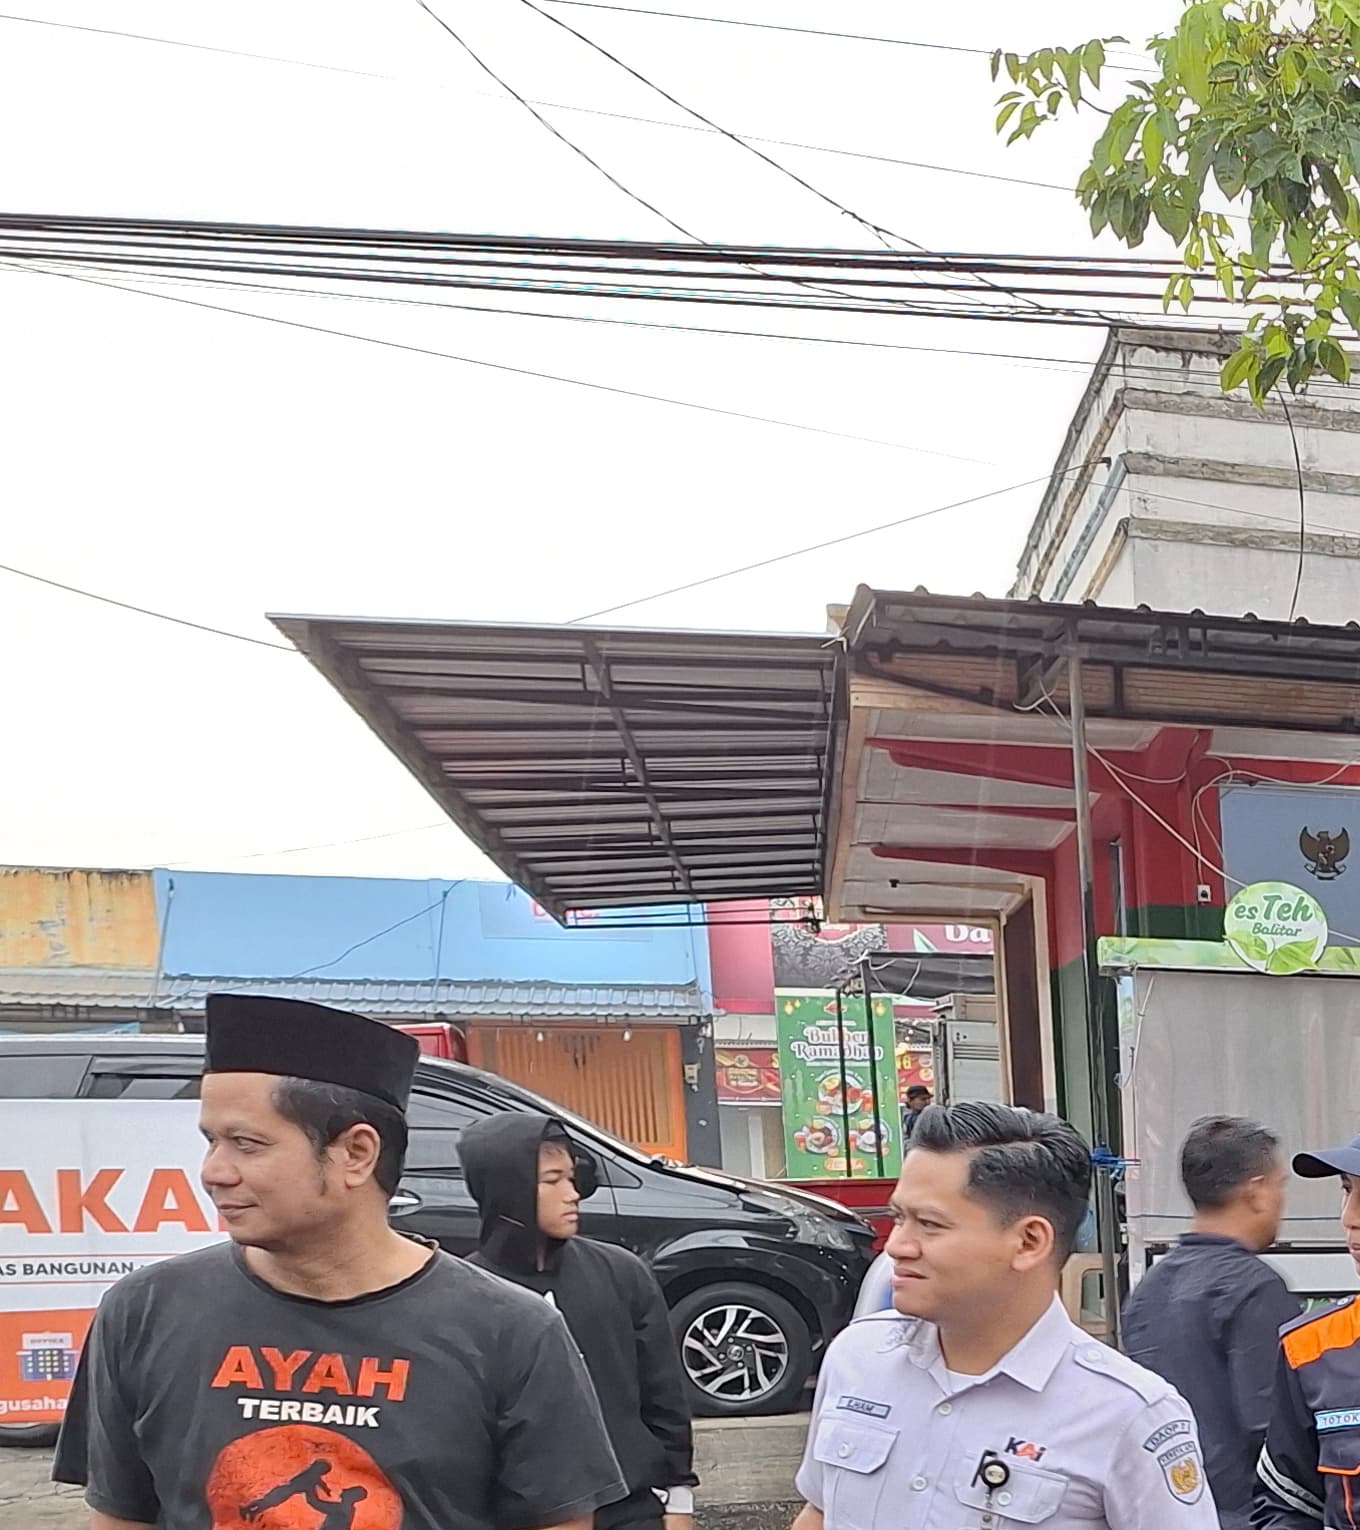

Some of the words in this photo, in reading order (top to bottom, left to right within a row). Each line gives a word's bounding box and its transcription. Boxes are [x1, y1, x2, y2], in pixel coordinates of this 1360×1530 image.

[1234, 904, 1259, 919] es
[1263, 894, 1314, 921] Teh
[0, 1168, 228, 1233] AKA
[22, 1261, 134, 1276] BANGUNAN
[210, 1345, 411, 1401] AYAH
[237, 1397, 381, 1428] TERBAIK
